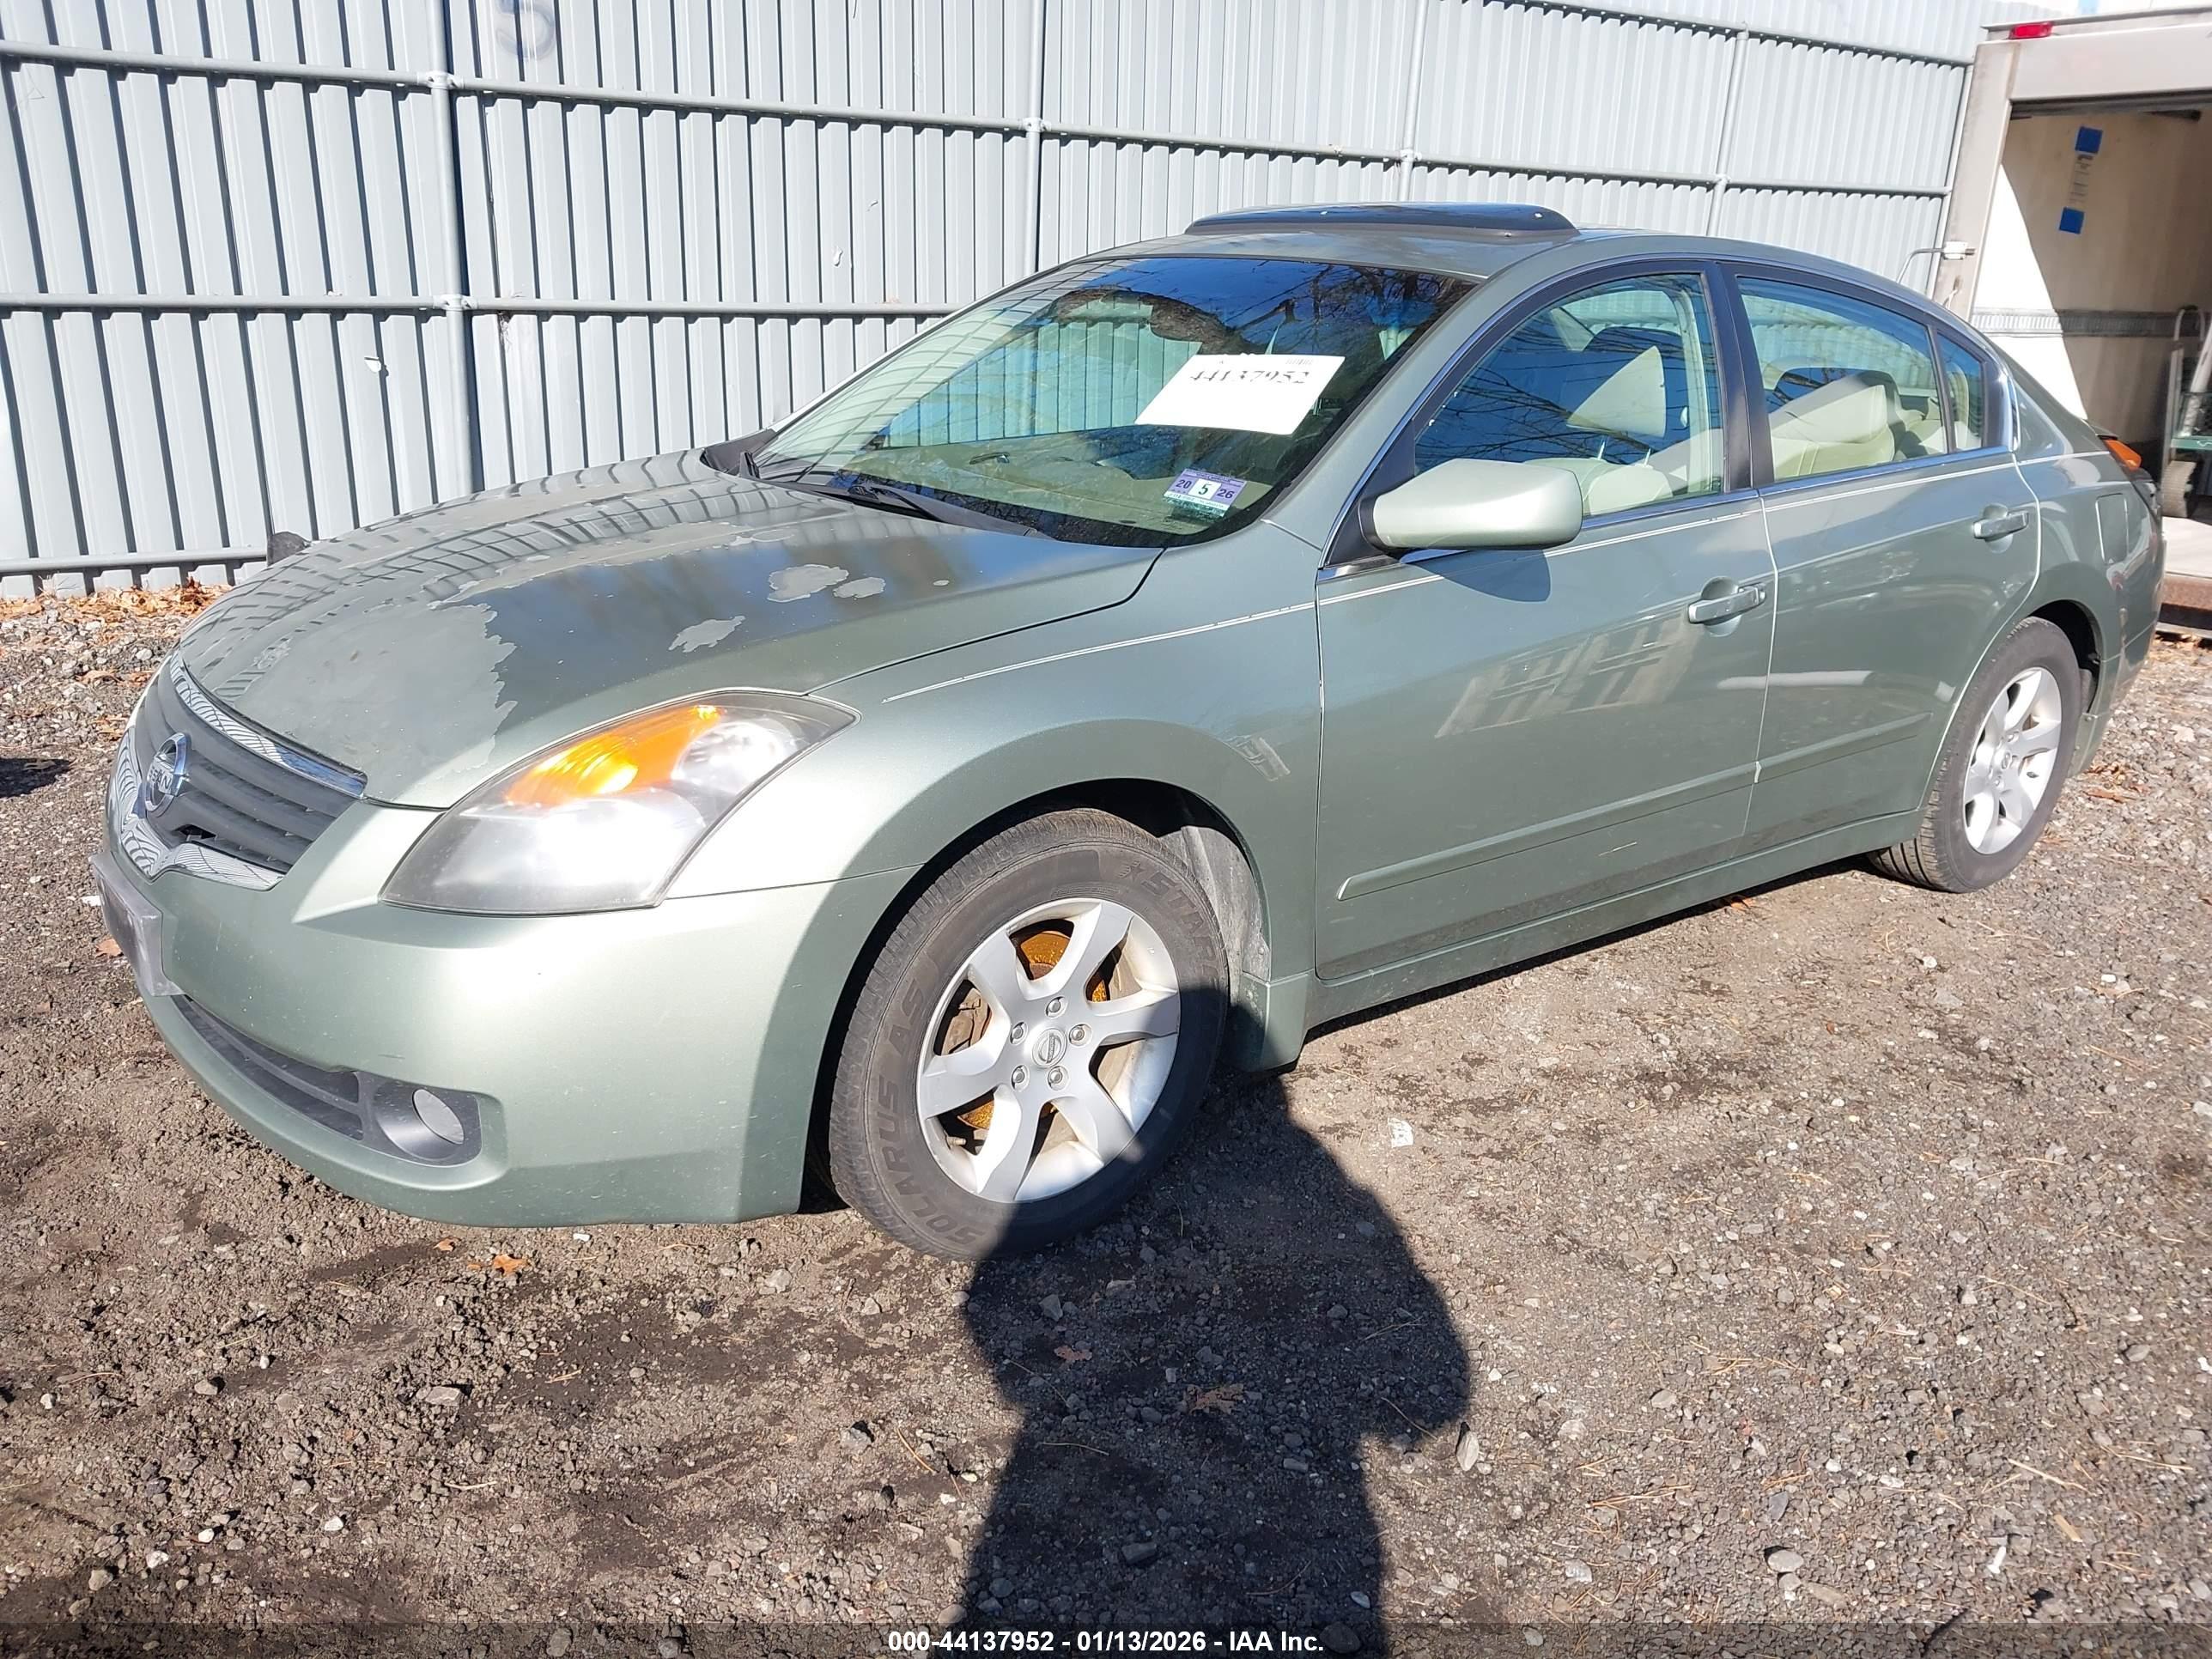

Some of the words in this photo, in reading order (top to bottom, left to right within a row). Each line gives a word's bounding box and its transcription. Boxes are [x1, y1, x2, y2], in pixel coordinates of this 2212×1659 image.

[1175, 479, 1193, 489] 20
[1198, 483, 1212, 495] 5
[1216, 489, 1236, 499] 26
[878, 1074, 985, 1245] SOLARUS
